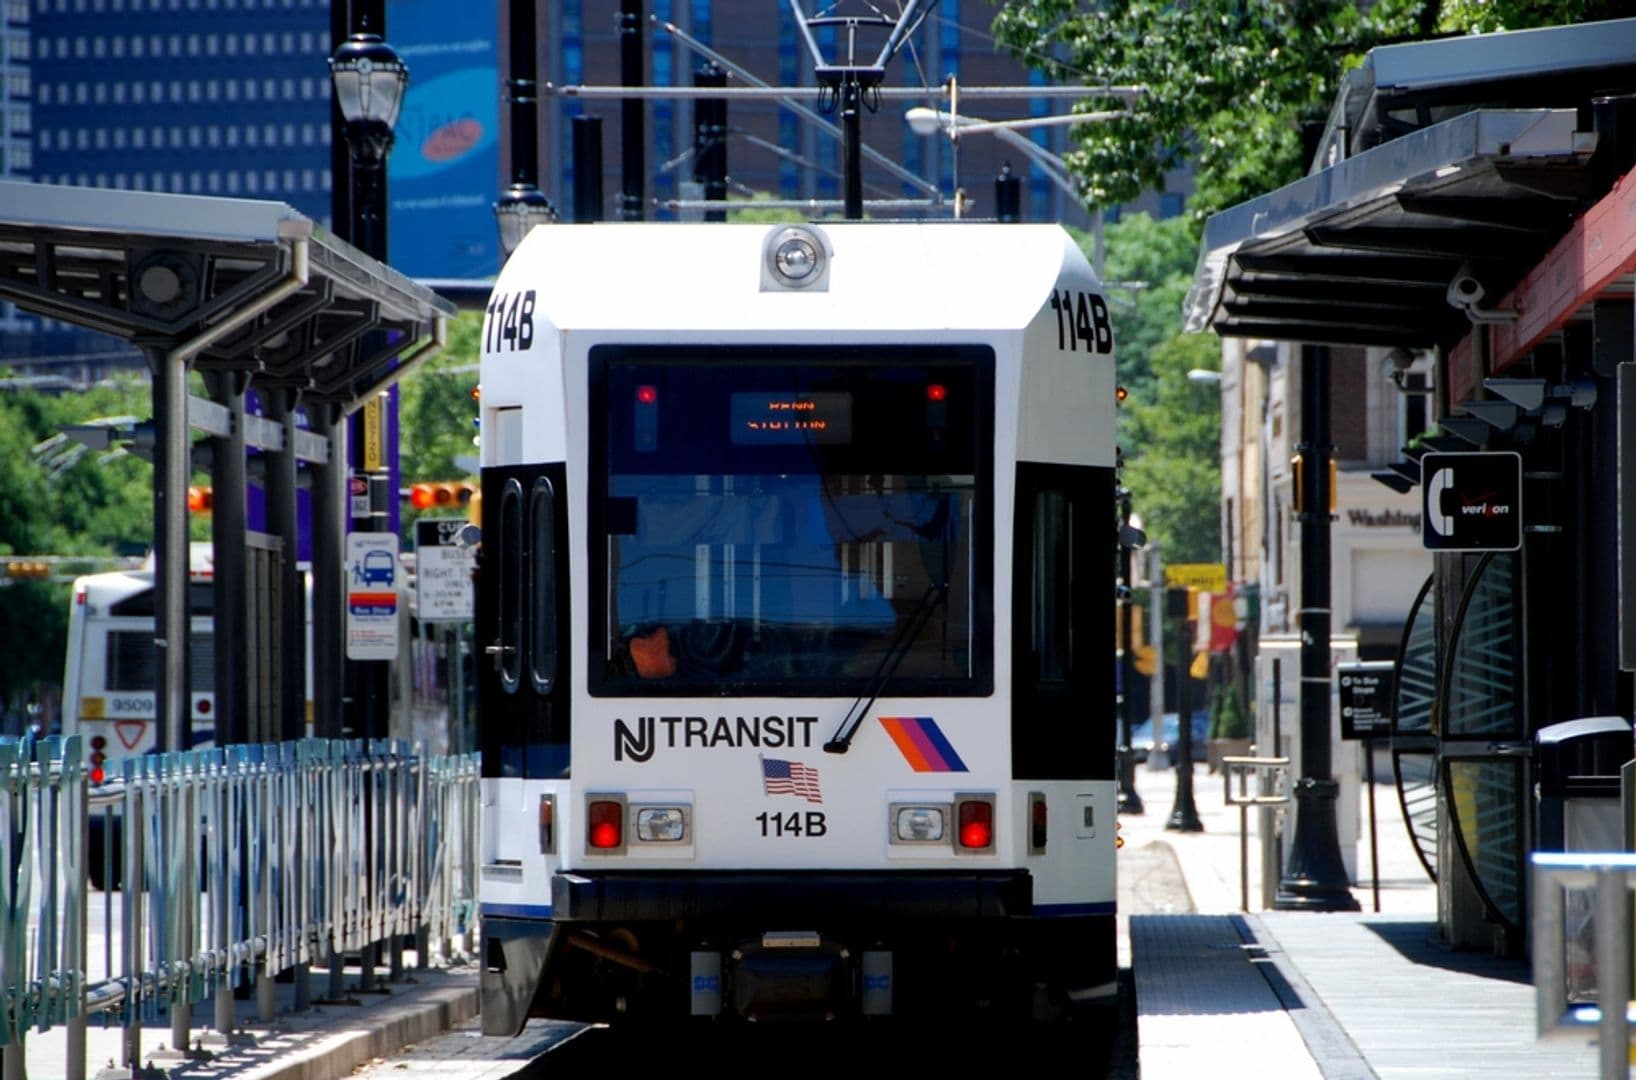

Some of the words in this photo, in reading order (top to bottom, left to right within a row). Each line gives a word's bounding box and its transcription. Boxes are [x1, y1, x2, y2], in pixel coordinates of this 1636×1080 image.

[486, 290, 536, 354] 114B
[1049, 288, 1113, 355] 114B
[614, 717, 655, 763] NJ
[660, 716, 819, 748] TRANSIT
[755, 811, 827, 838] 114B
